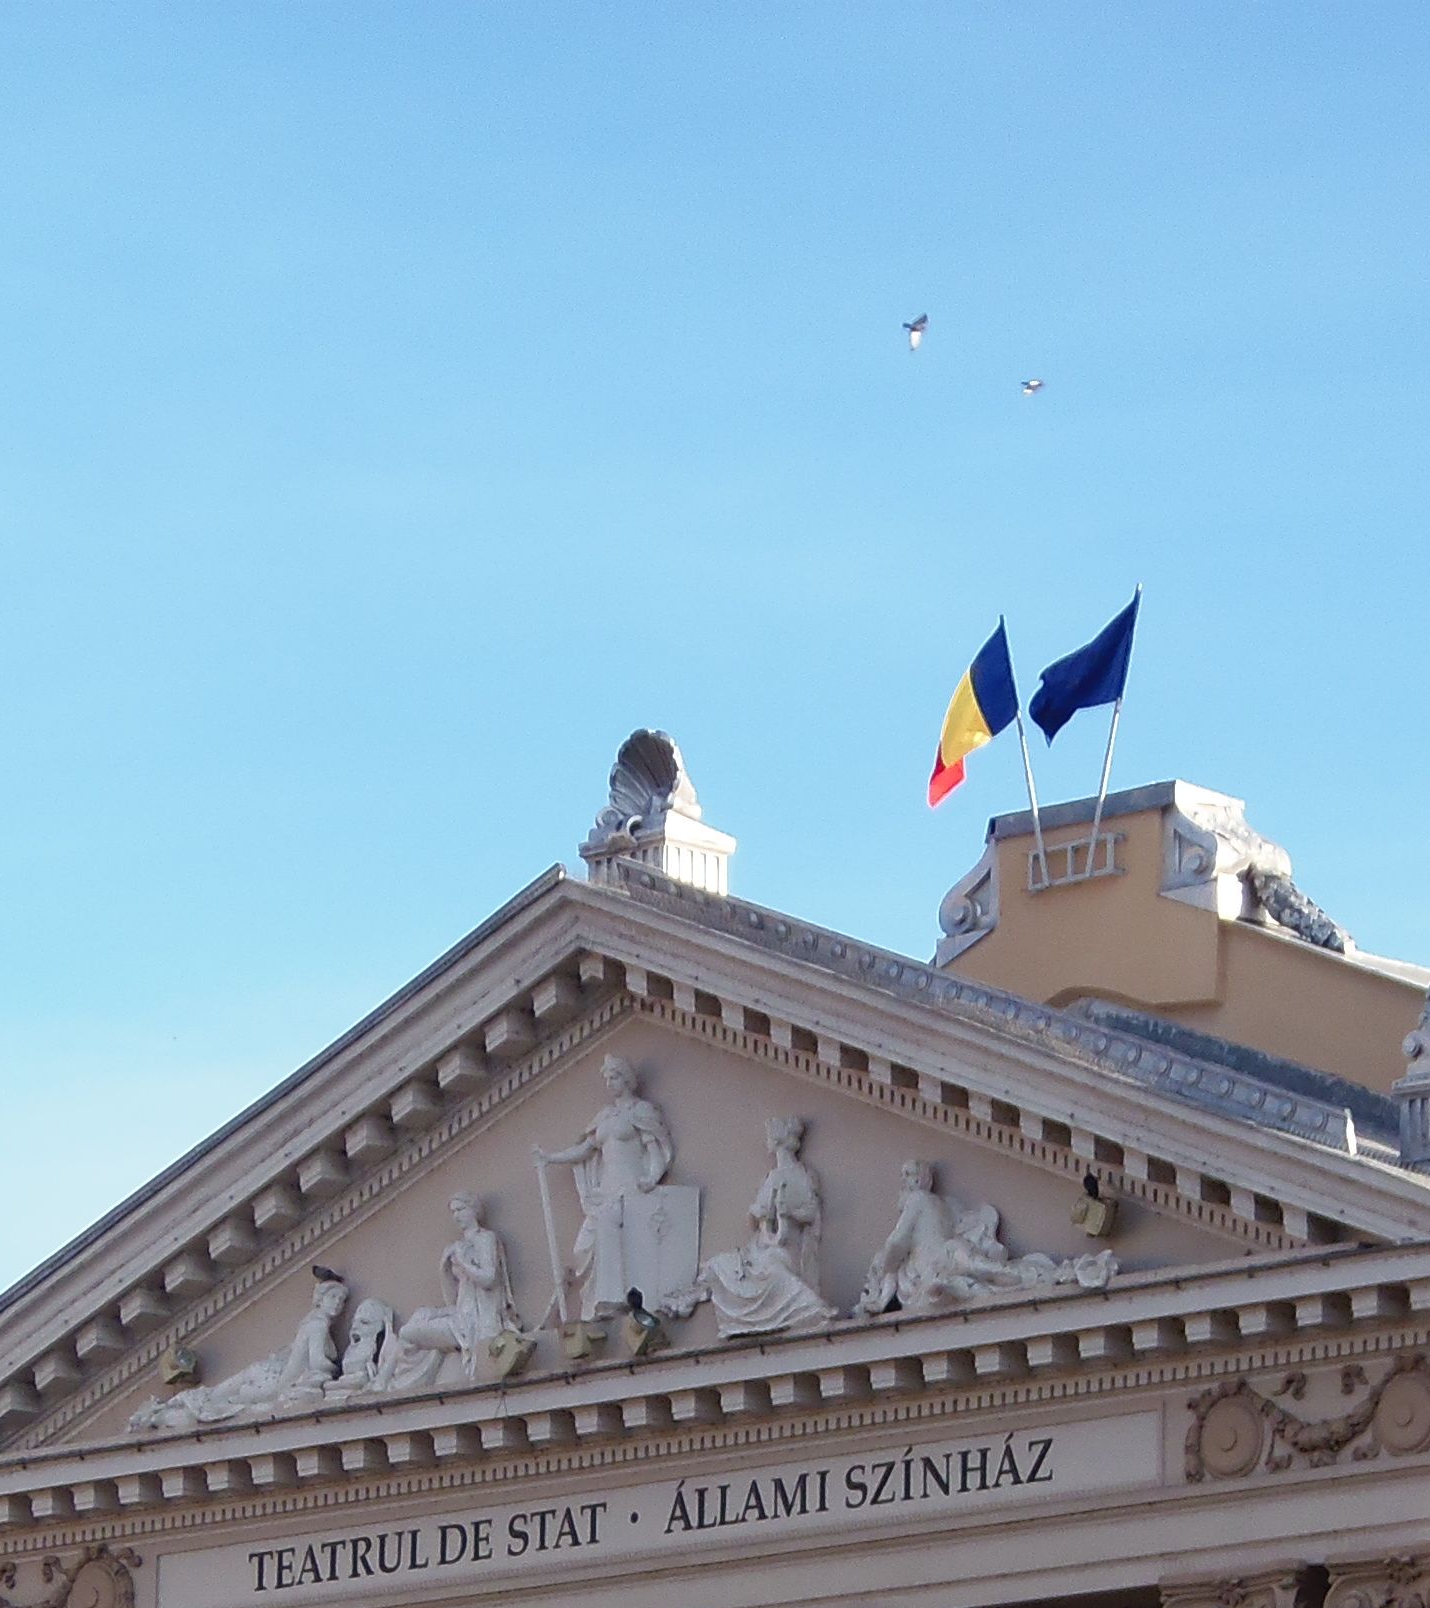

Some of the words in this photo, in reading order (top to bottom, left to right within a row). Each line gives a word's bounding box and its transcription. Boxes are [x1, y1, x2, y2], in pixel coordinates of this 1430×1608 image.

[248, 1528, 429, 1592] TEATRUL
[437, 1518, 493, 1566] DE
[507, 1501, 607, 1557] STAT
[663, 1469, 831, 1535] ÁLLAMI
[844, 1431, 1054, 1509] SZÍNHÁZ
